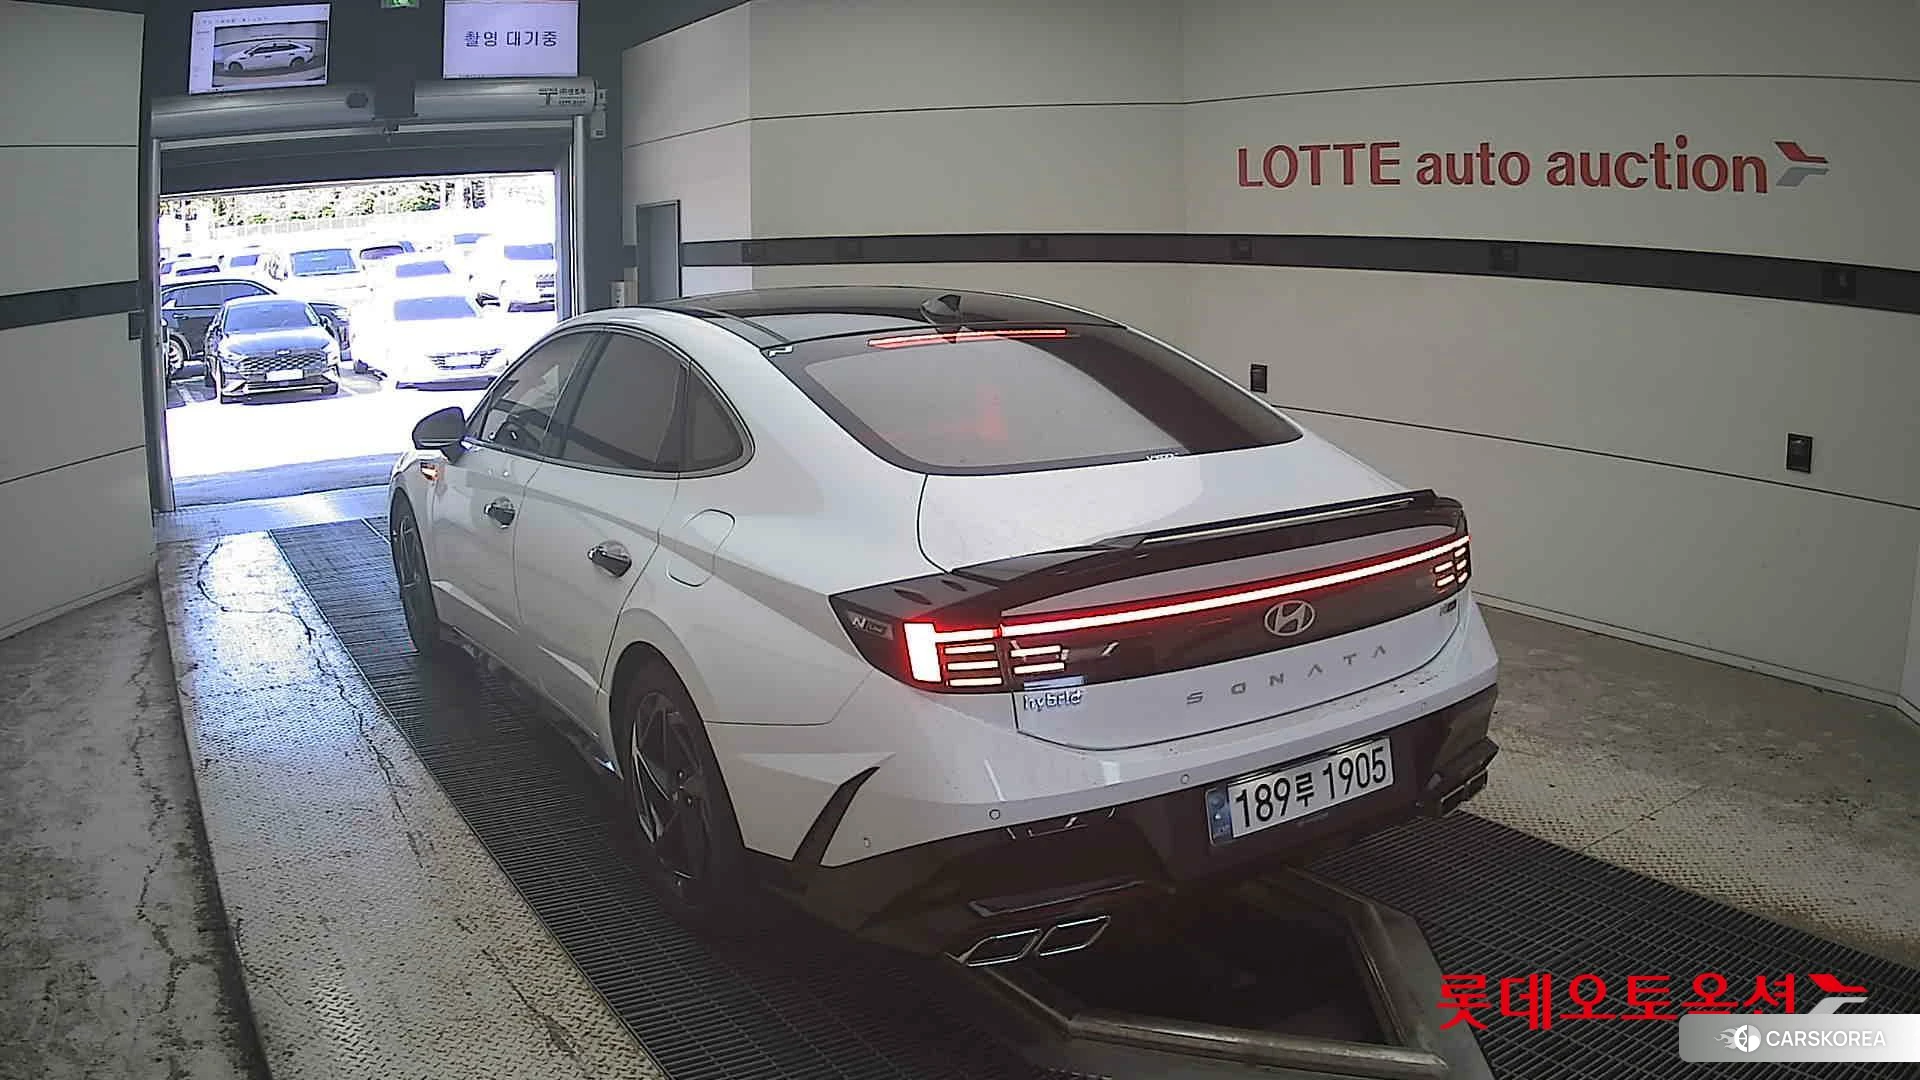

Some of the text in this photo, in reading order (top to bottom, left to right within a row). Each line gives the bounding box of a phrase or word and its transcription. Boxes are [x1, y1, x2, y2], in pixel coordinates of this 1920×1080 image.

[506, 31, 558, 48] 대기중
[1238, 134, 1769, 194] LOTTE auto auction
[1023, 688, 1084, 712] hybrid
[1186, 645, 1387, 705] SONATA
[1234, 746, 1387, 829] 189루 1905
